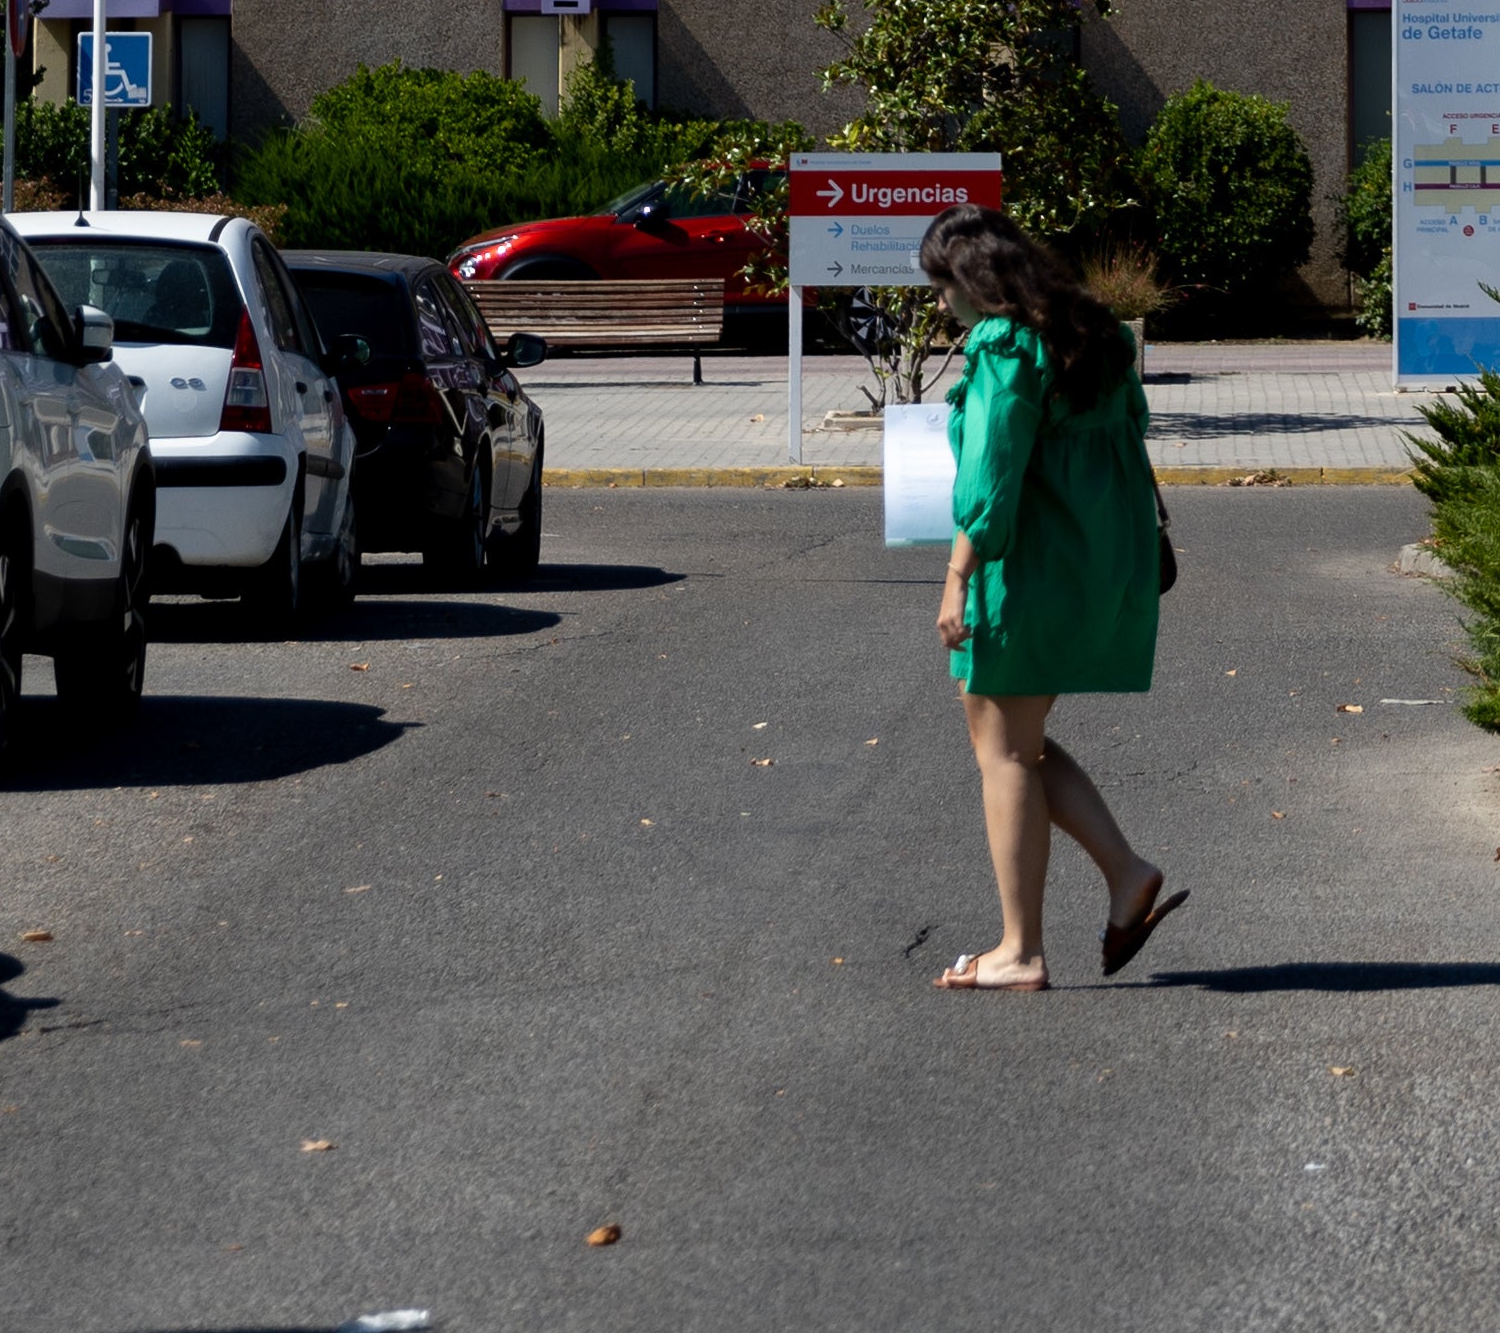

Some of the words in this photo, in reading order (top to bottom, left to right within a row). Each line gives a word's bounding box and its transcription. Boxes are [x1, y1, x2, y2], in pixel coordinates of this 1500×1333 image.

[1402, 13, 1450, 25] Hospital
[1402, 25, 1422, 40] de
[1428, 25, 1483, 40] Getafe
[1412, 80, 1453, 94] SALÓN
[1456, 83, 1472, 94] DE
[1450, 124, 1458, 134] F
[1492, 124, 1500, 134] E
[1403, 158, 1413, 169] G
[1403, 182, 1412, 192] H
[851, 184, 969, 208] Urgencias
[1449, 216, 1458, 225] A
[1479, 215, 1488, 225] B
[851, 224, 891, 235] Duelos
[851, 240, 922, 251] Rehabilitació
[851, 263, 915, 275] Mercancías
